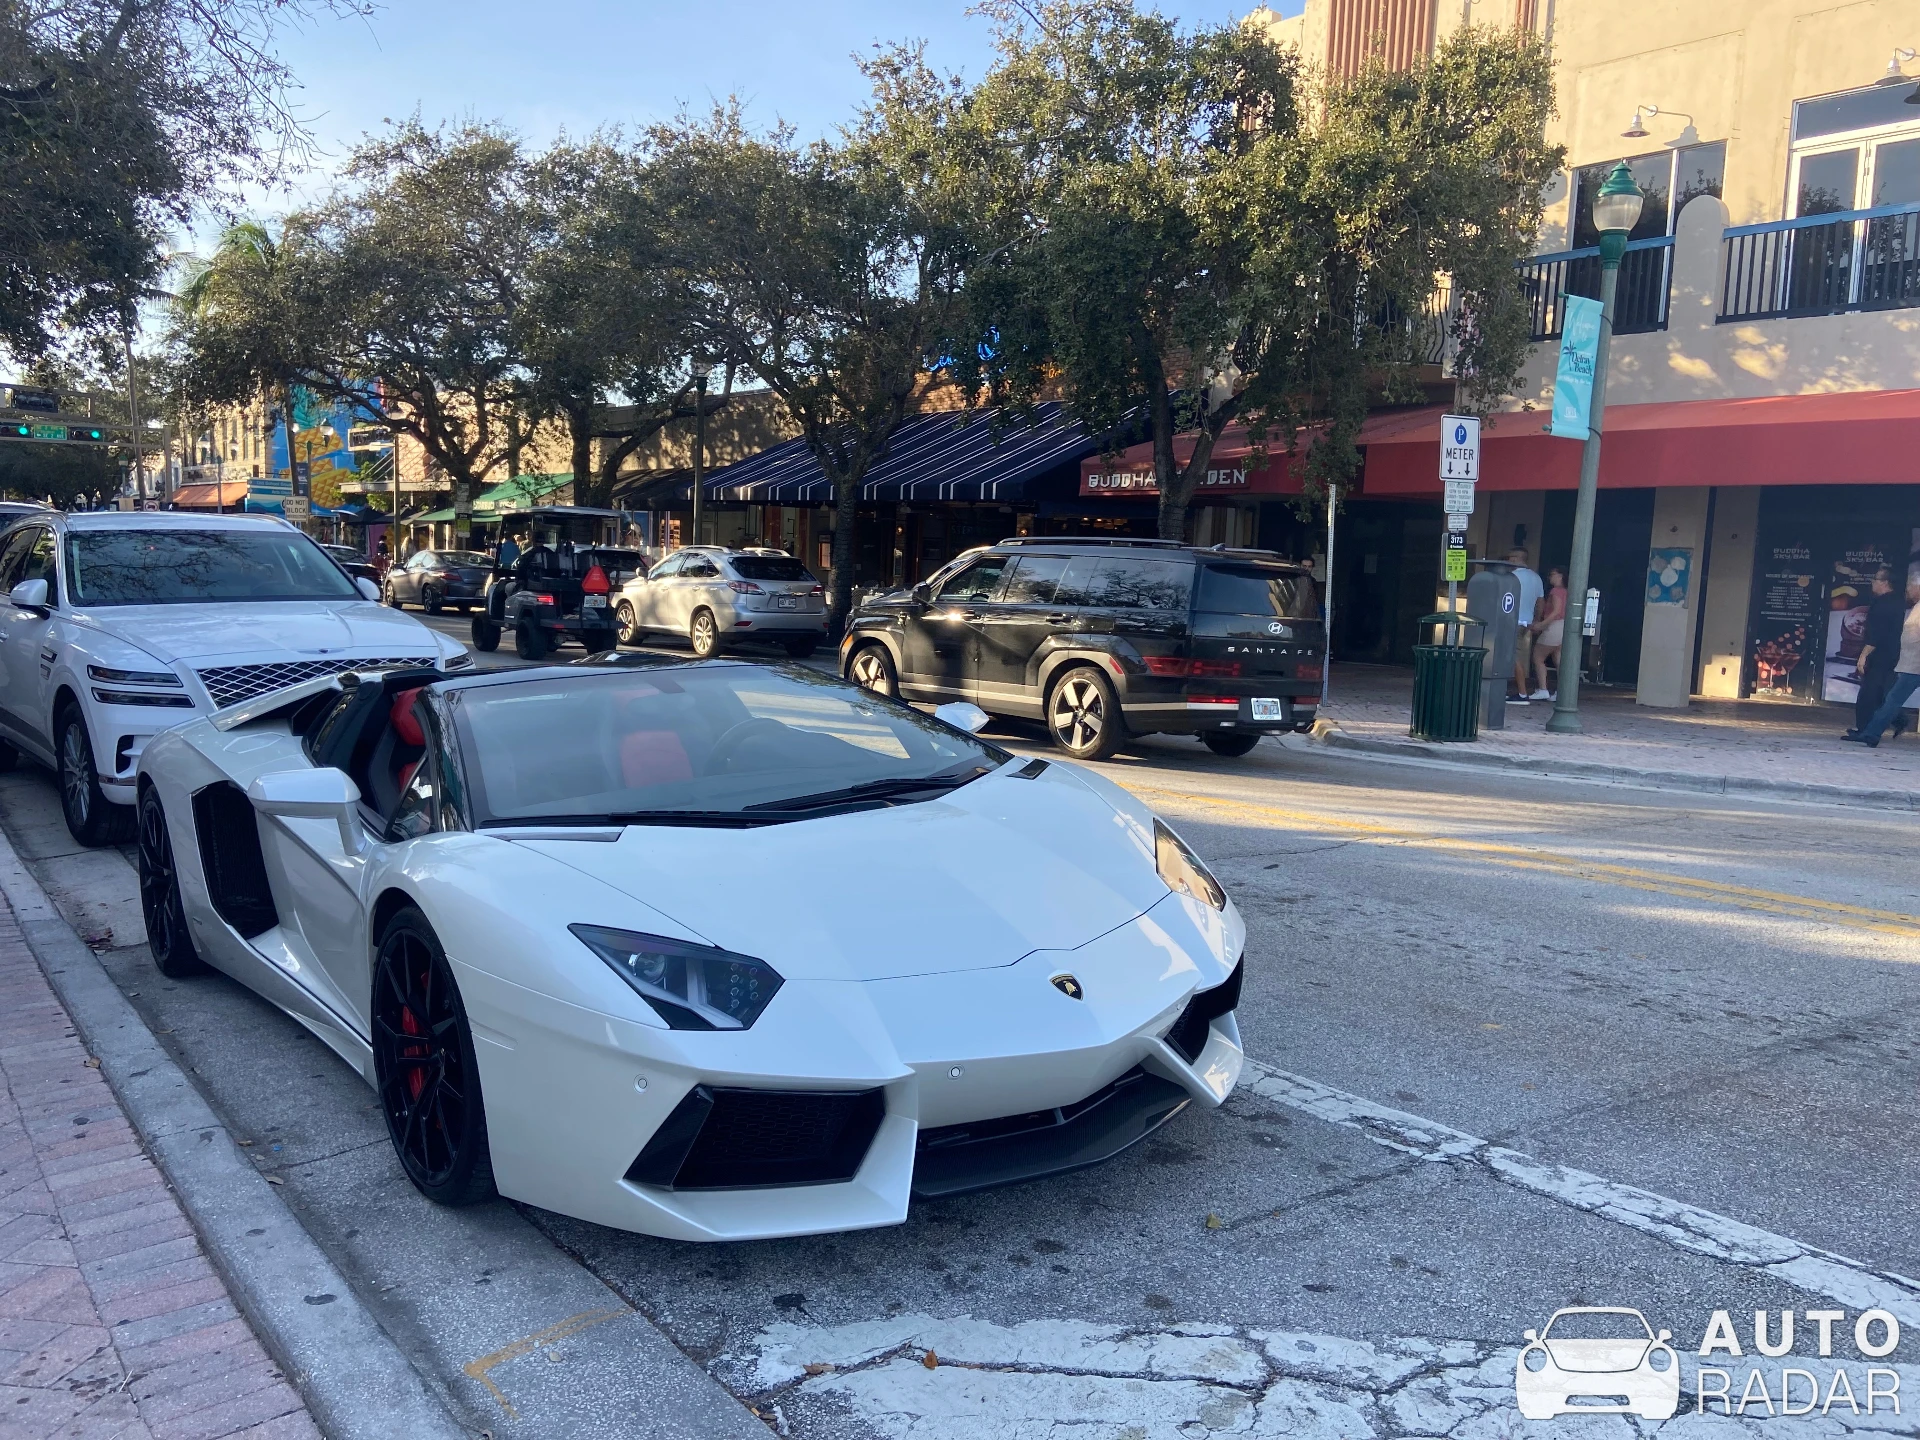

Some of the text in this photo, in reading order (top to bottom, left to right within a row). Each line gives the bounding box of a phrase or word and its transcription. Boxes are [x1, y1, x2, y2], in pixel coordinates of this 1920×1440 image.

[1573, 362, 1593, 376] Beach
[1458, 428, 1465, 441] P
[1445, 447, 1474, 460] METER
[1088, 471, 1157, 488] BUDDHA
[1450, 536, 1464, 544] 3173
[1504, 595, 1513, 611] P
[1227, 645, 1288, 656] SANTA
